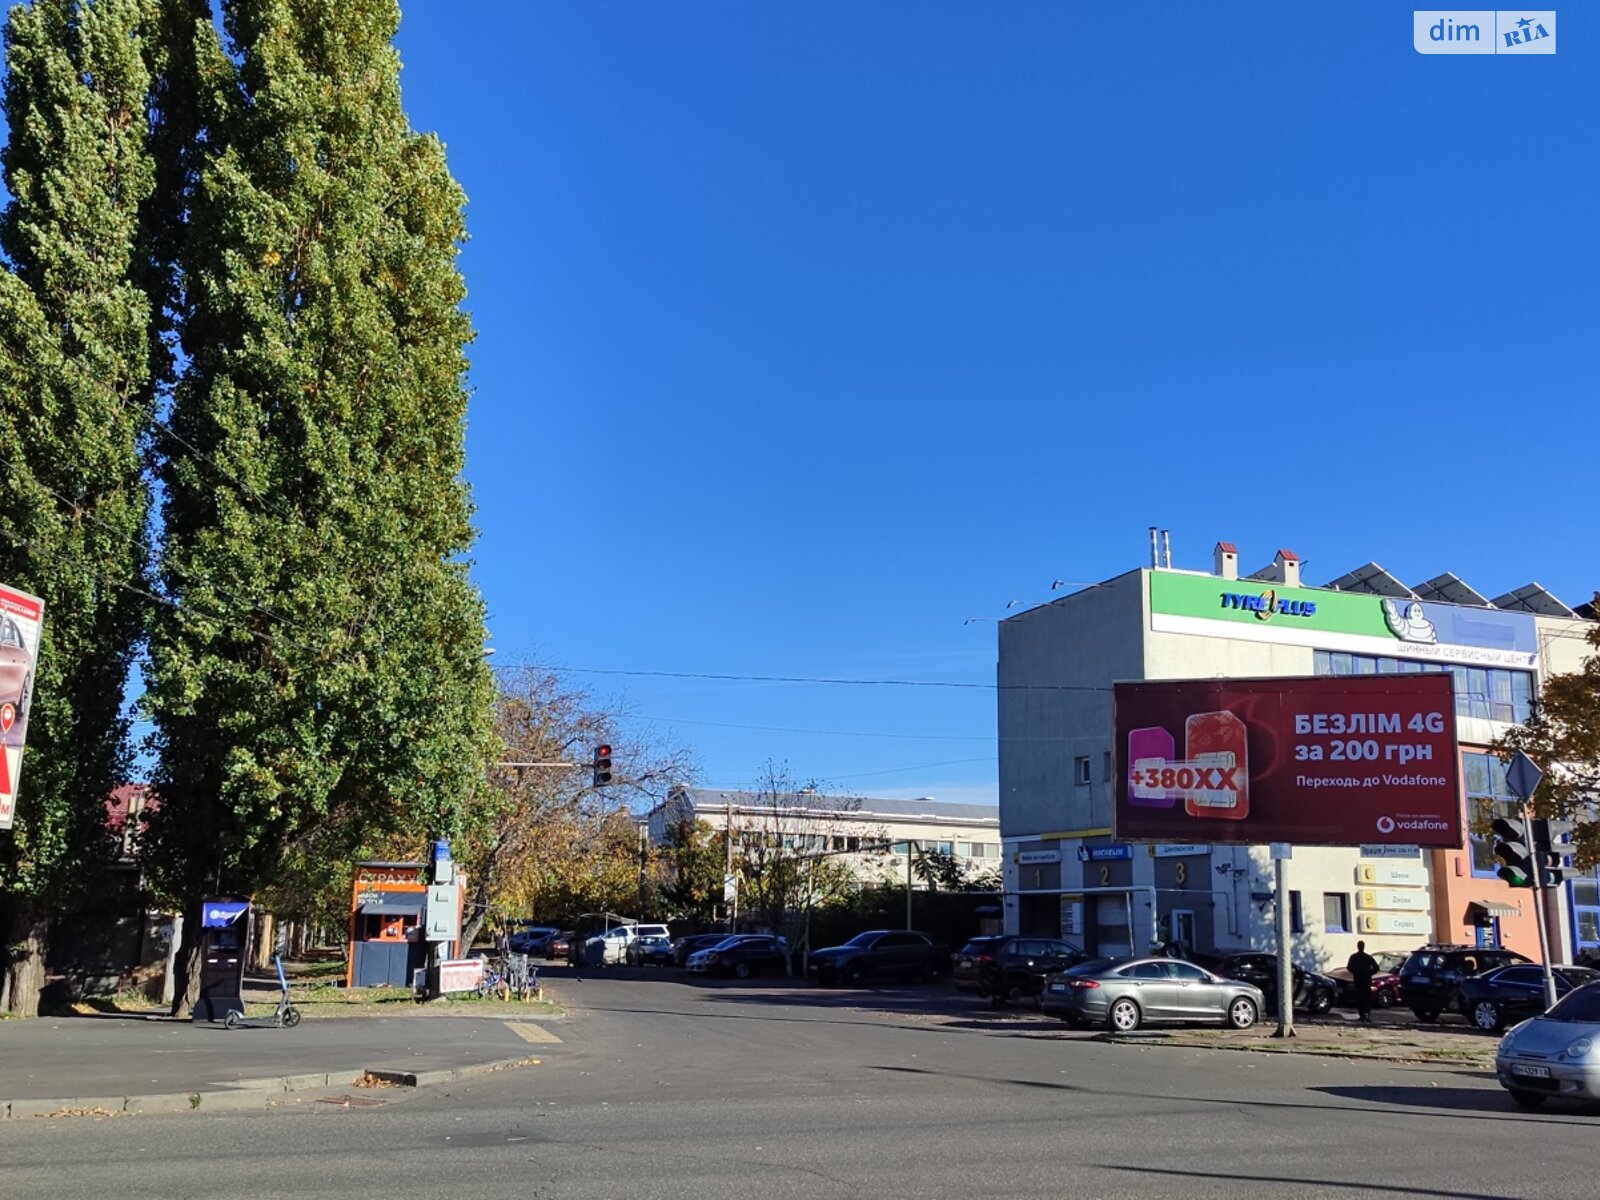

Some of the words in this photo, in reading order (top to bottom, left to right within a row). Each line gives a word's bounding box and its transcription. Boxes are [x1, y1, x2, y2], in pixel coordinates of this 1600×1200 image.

[1397, 643, 1442, 656] ШИННЫЙ
[1443, 647, 1501, 662] СЕРВИСНЫЙ
[1504, 654, 1535, 665] ЦЕНТ
[1295, 713, 1402, 735] БЕЗЛІМ
[1407, 712, 1445, 734] 4G
[1295, 744, 1324, 761] за
[1330, 740, 1379, 761] 200
[1385, 744, 1433, 765] грн
[1296, 775, 1361, 789] Переходь
[1363, 777, 1380, 788] до
[1383, 774, 1446, 786] Vodafone
[1397, 820, 1449, 831] vodafone
[1101, 866, 1110, 886] 2
[1175, 862, 1185, 884] 3
